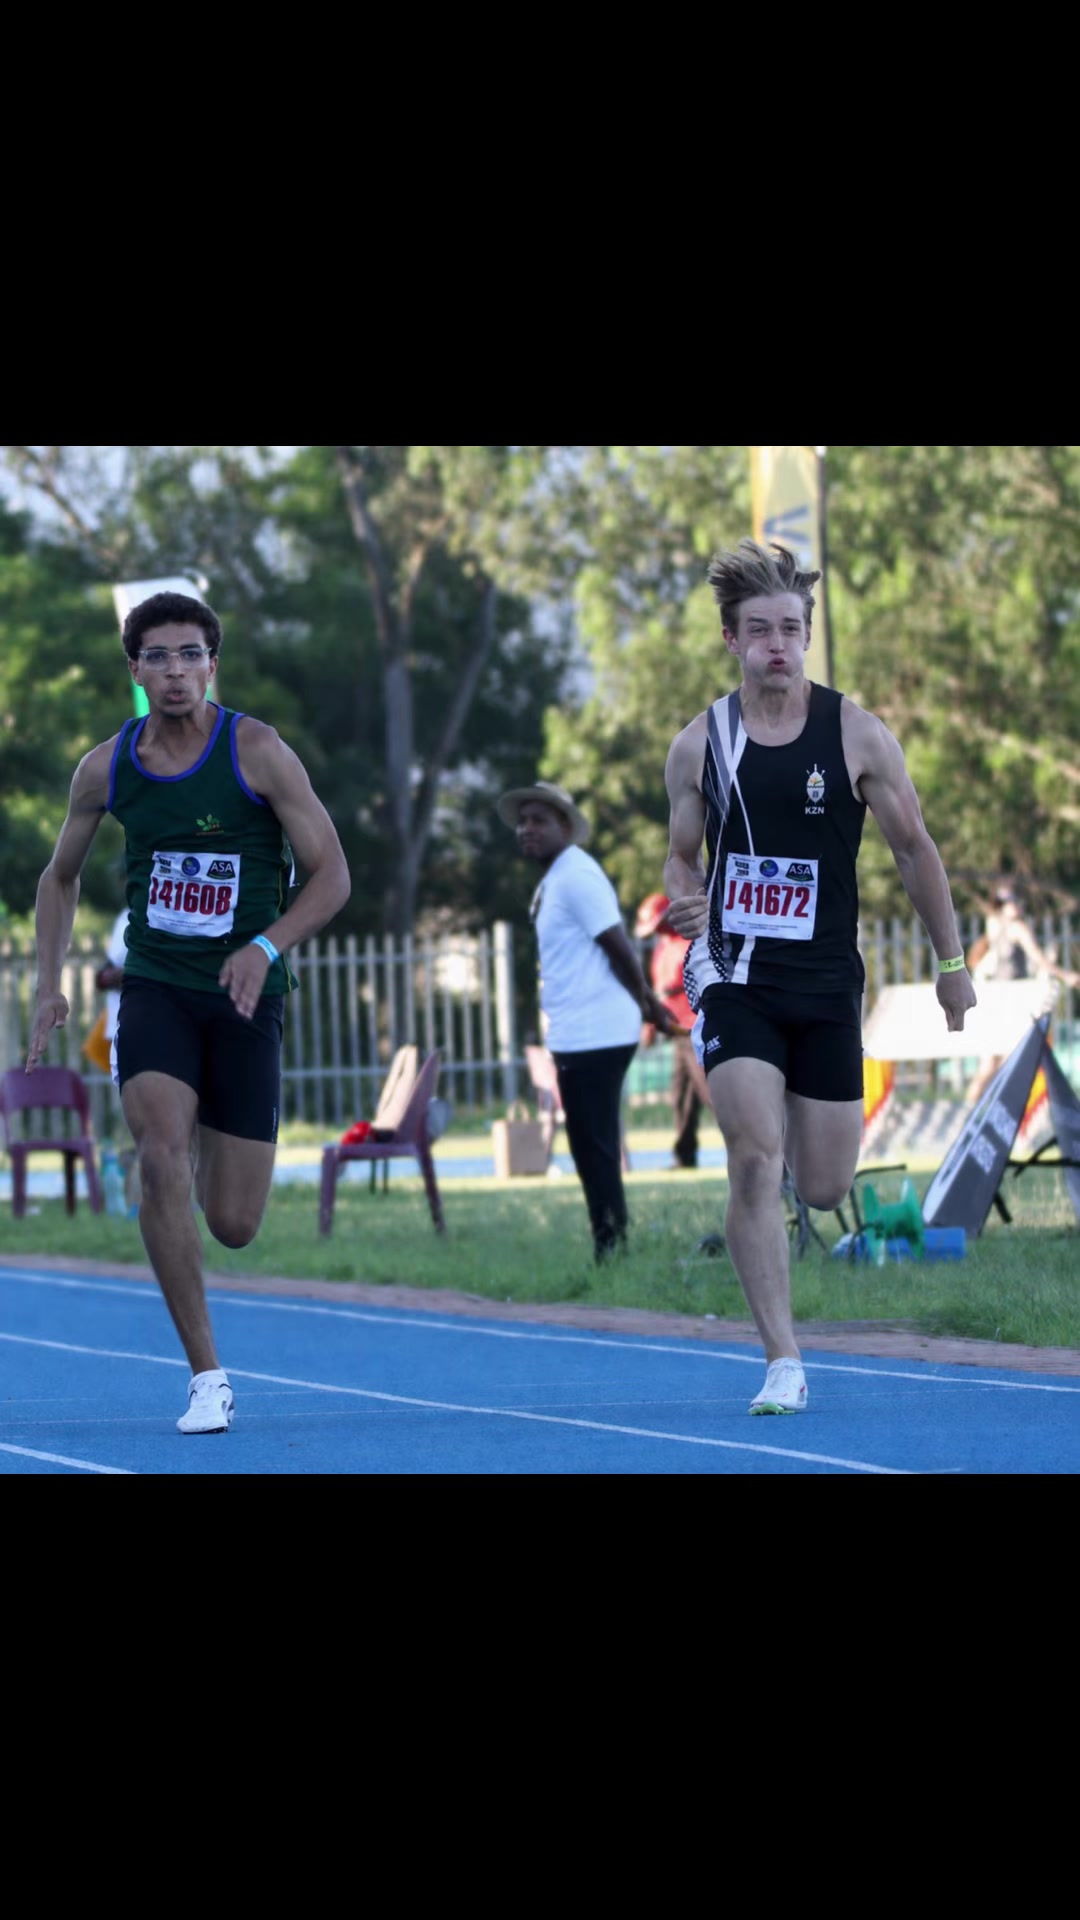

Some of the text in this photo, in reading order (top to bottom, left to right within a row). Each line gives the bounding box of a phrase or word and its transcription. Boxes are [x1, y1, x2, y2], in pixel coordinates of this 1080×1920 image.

[805, 806, 825, 815] KZN
[210, 860, 233, 873] ASA
[789, 864, 811, 876] ASA
[149, 876, 233, 916] J41608
[725, 879, 811, 918] J41672
